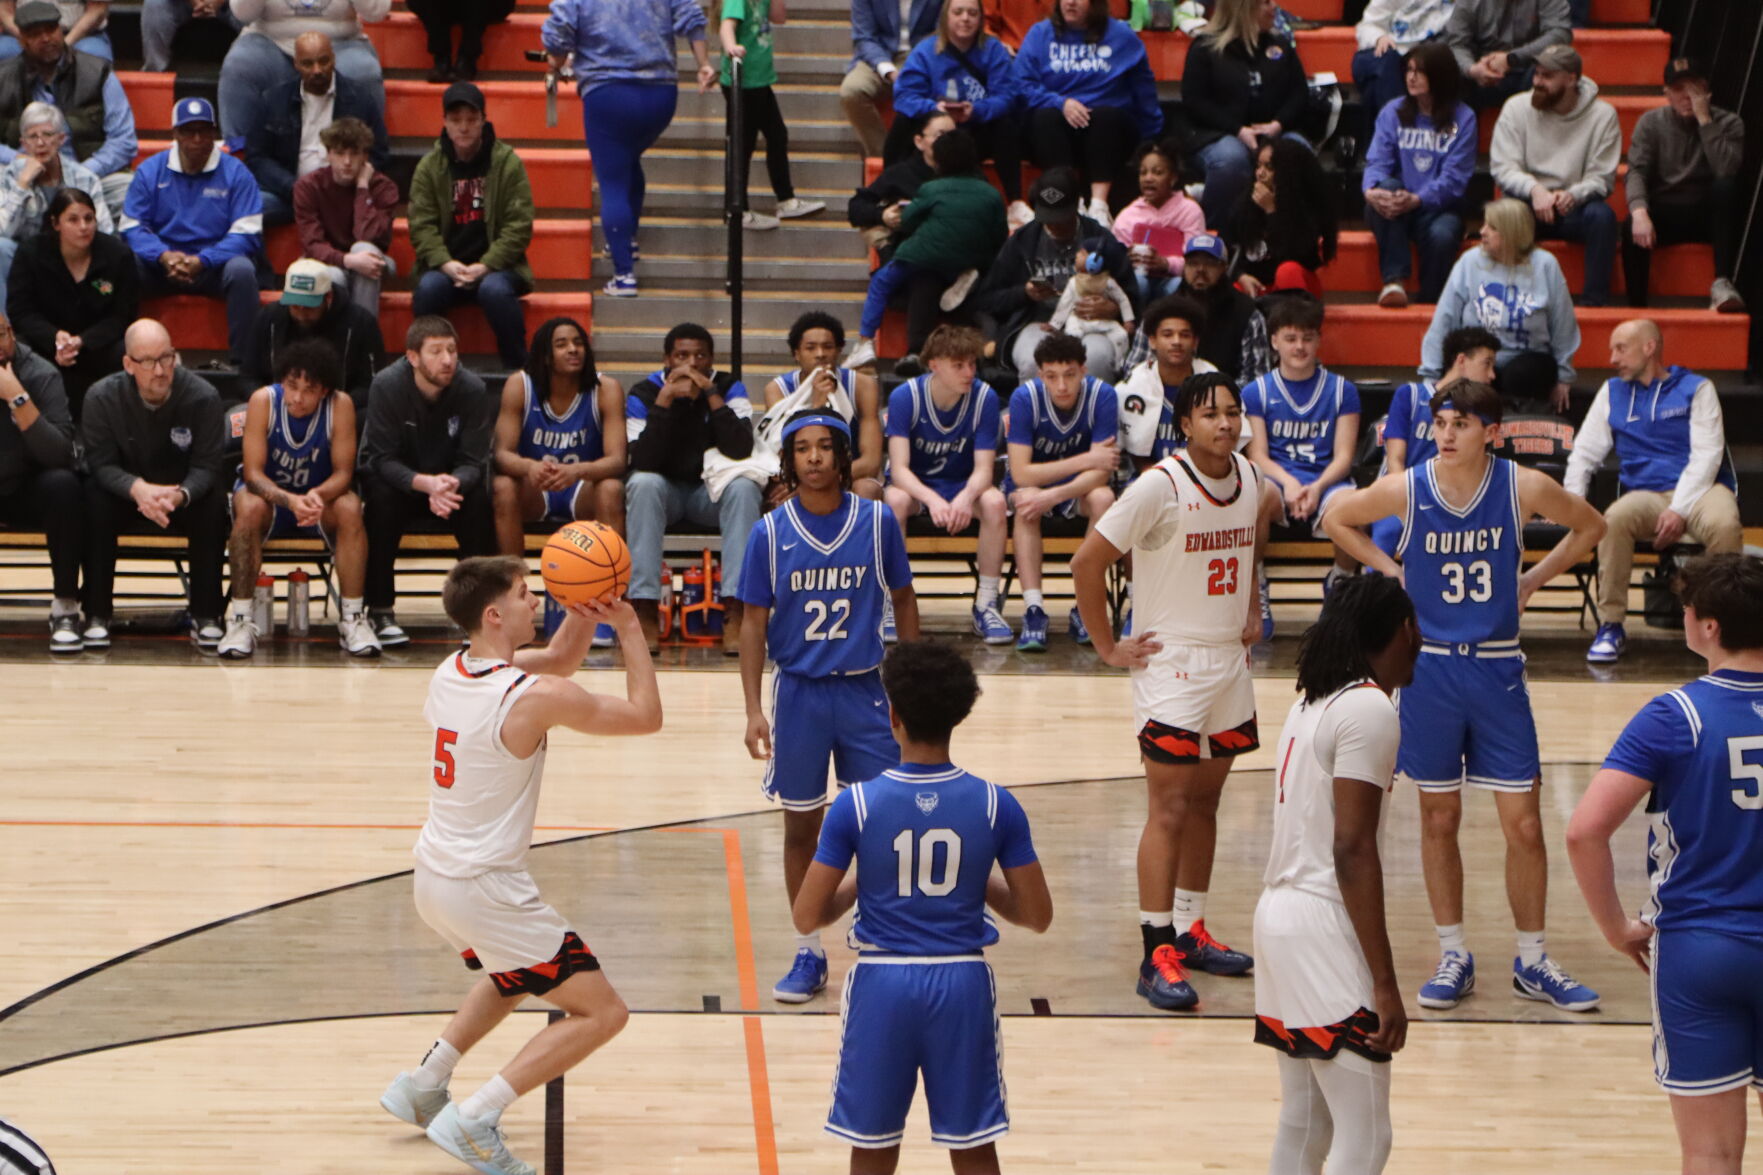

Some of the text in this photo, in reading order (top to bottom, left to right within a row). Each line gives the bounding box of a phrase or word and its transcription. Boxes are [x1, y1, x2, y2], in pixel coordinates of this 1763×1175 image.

[533, 428, 587, 449] QUINCY
[1273, 419, 1330, 439] QUINCY
[272, 448, 320, 470] QUINY
[1425, 526, 1503, 555] QUINCY
[790, 565, 868, 592] QUINCY
[1207, 556, 1239, 597] 23
[1440, 560, 1493, 604] 33
[804, 598, 851, 641] 22
[434, 727, 458, 790] 5
[893, 827, 962, 897] 10
